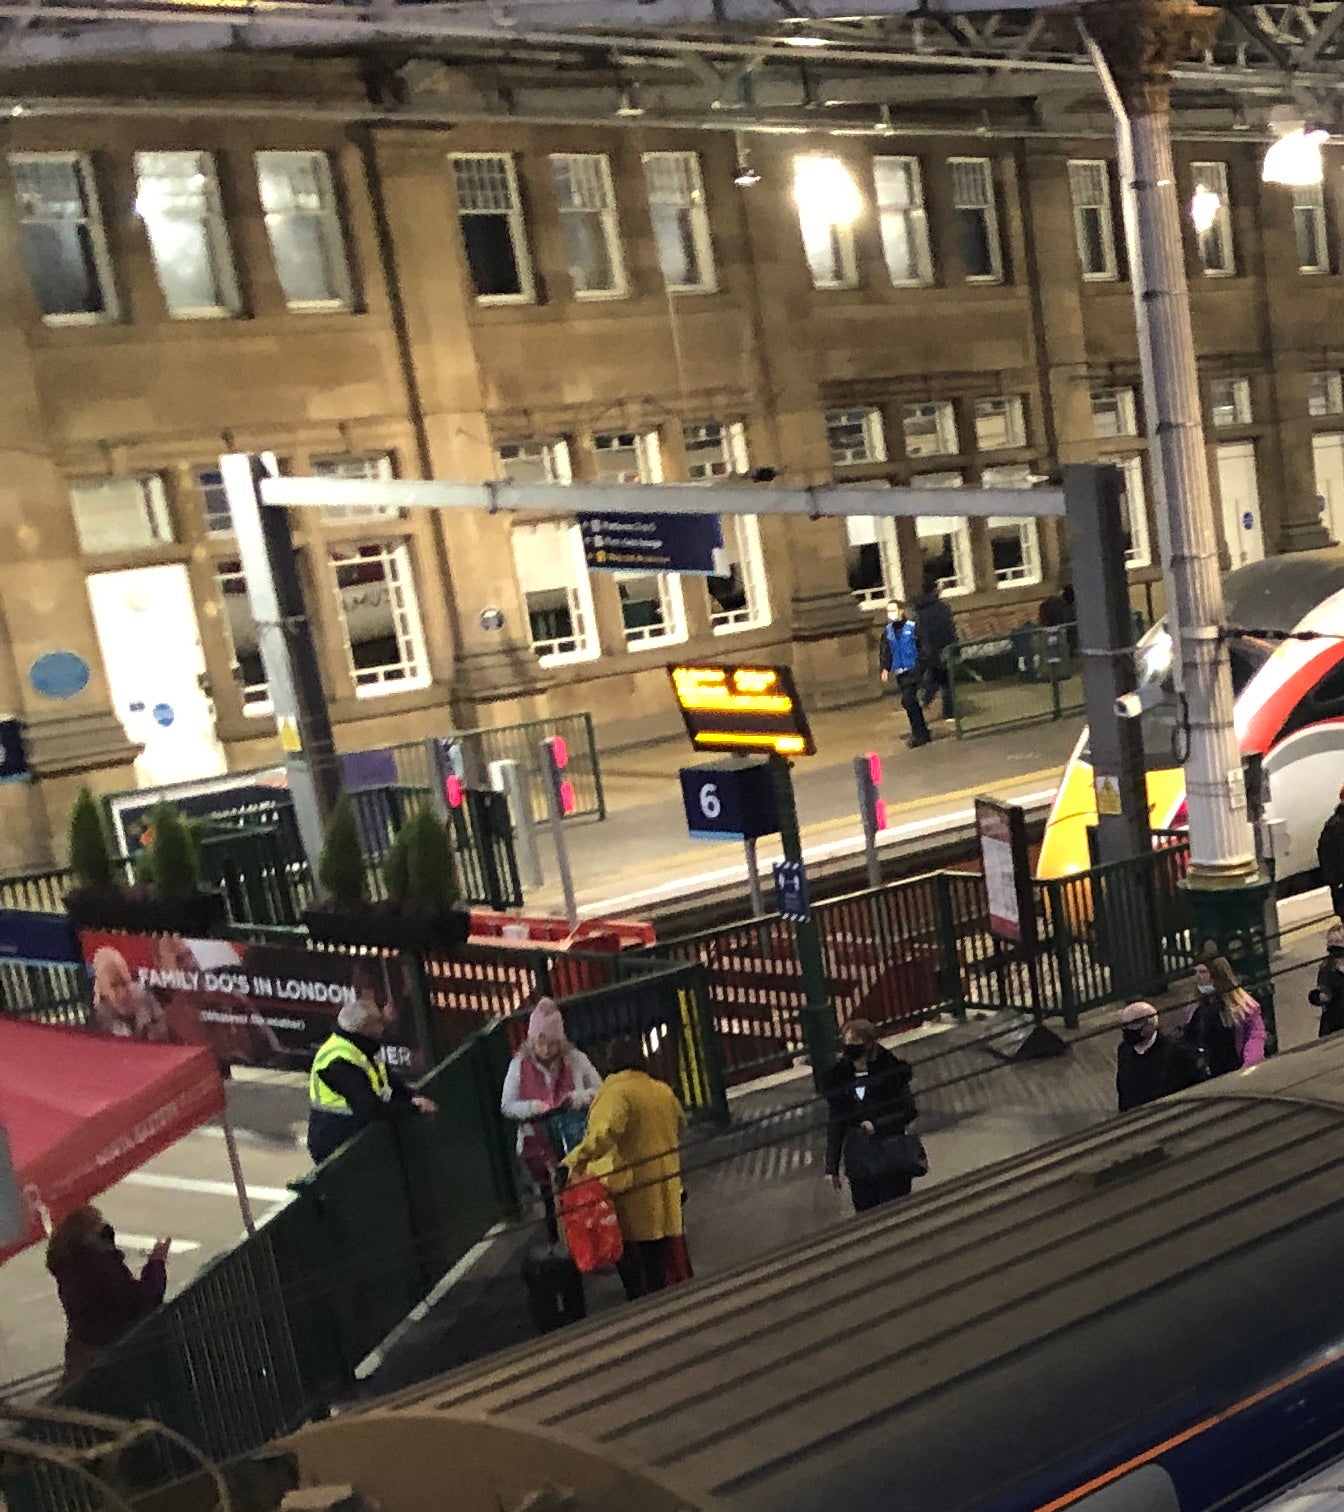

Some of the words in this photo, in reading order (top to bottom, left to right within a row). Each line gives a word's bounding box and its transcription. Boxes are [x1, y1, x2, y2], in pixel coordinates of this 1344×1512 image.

[699, 783, 721, 819] 6
[137, 966, 199, 991] FAMILY
[204, 972, 250, 993] DO'S
[253, 976, 273, 996] IN
[275, 978, 357, 1004] LONDON
